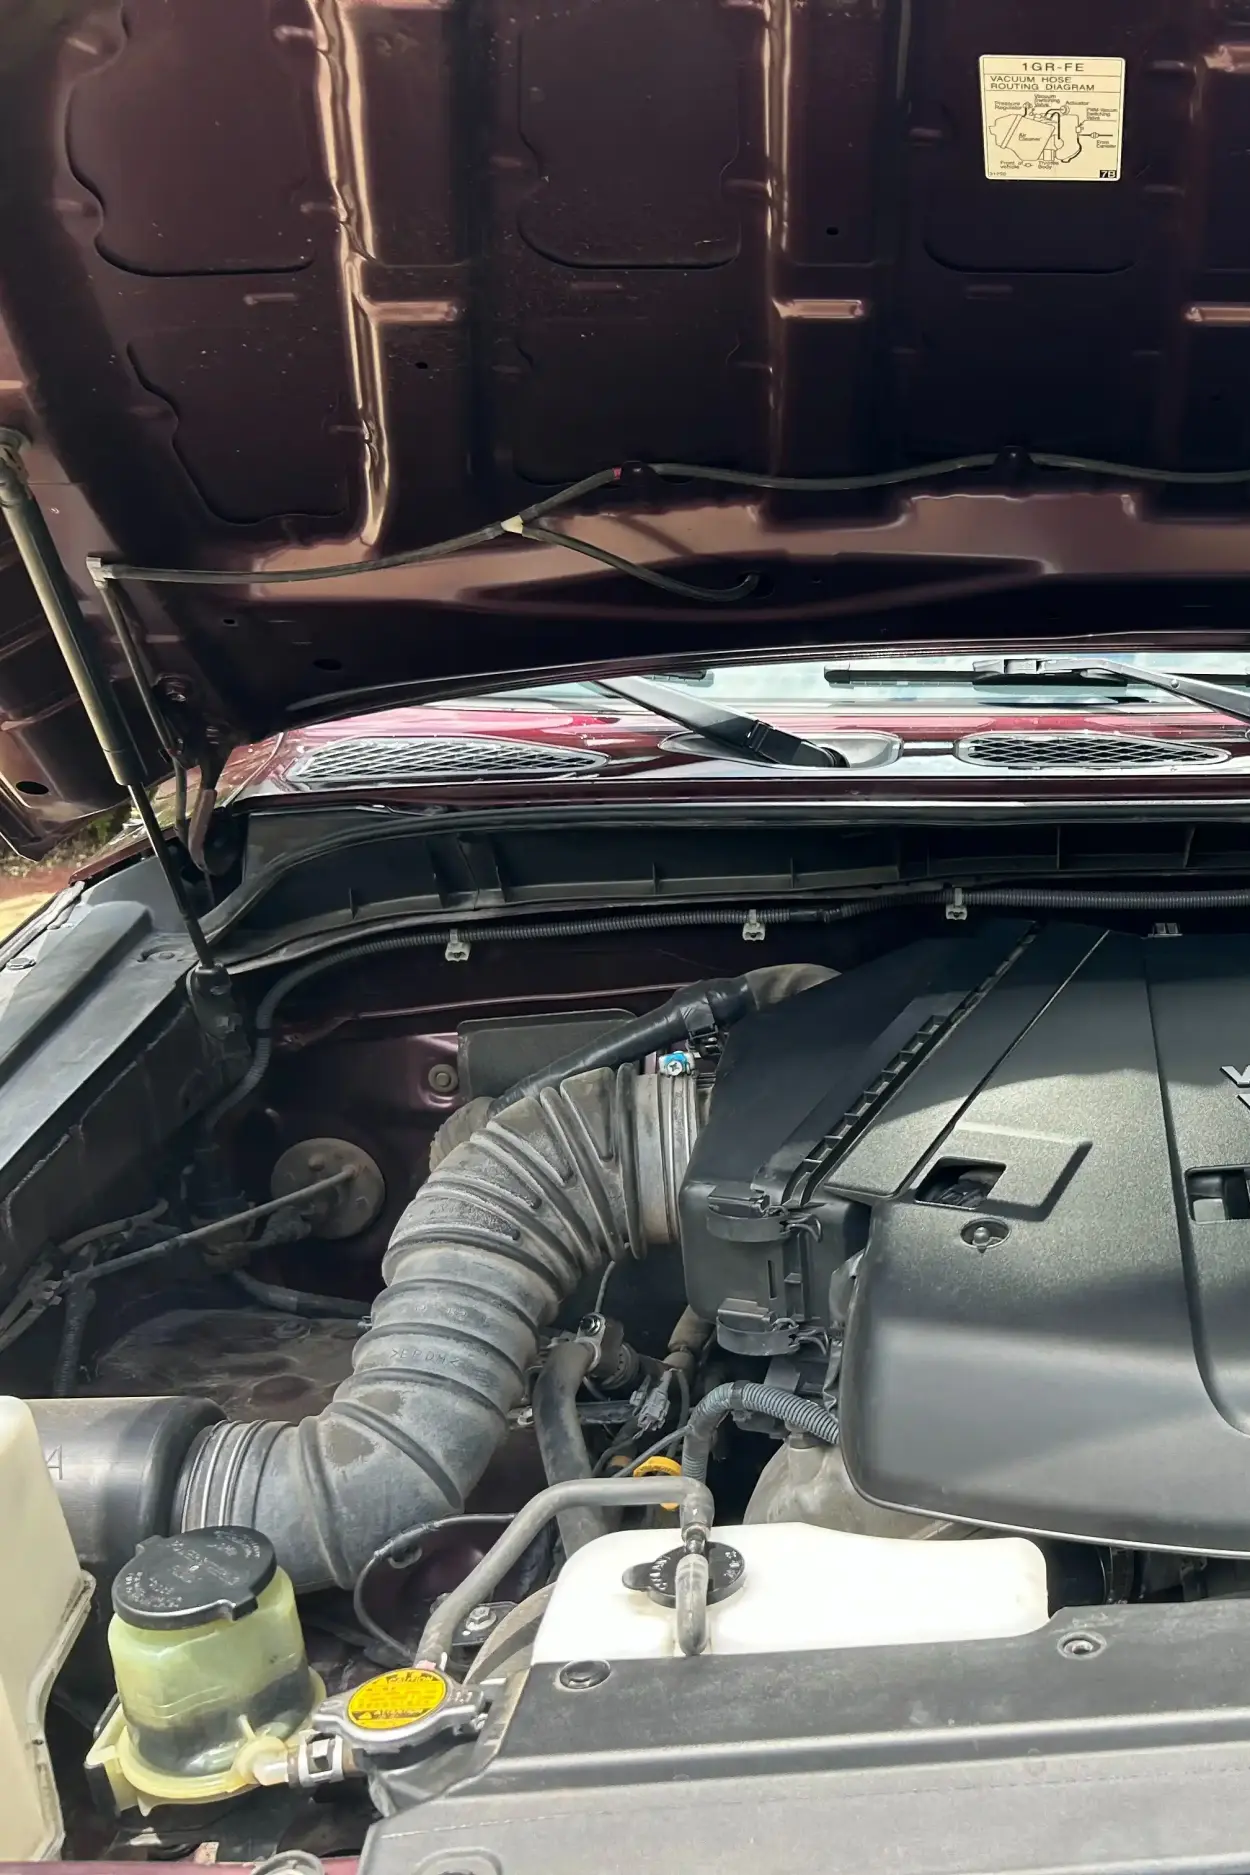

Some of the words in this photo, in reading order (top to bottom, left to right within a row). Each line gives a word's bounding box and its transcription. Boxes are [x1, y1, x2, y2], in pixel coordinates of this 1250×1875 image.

[1022, 62, 1085, 72] 1GR-FE
[1041, 76, 1072, 84] HOSE
[1045, 84, 1096, 92] DIAGRAM
